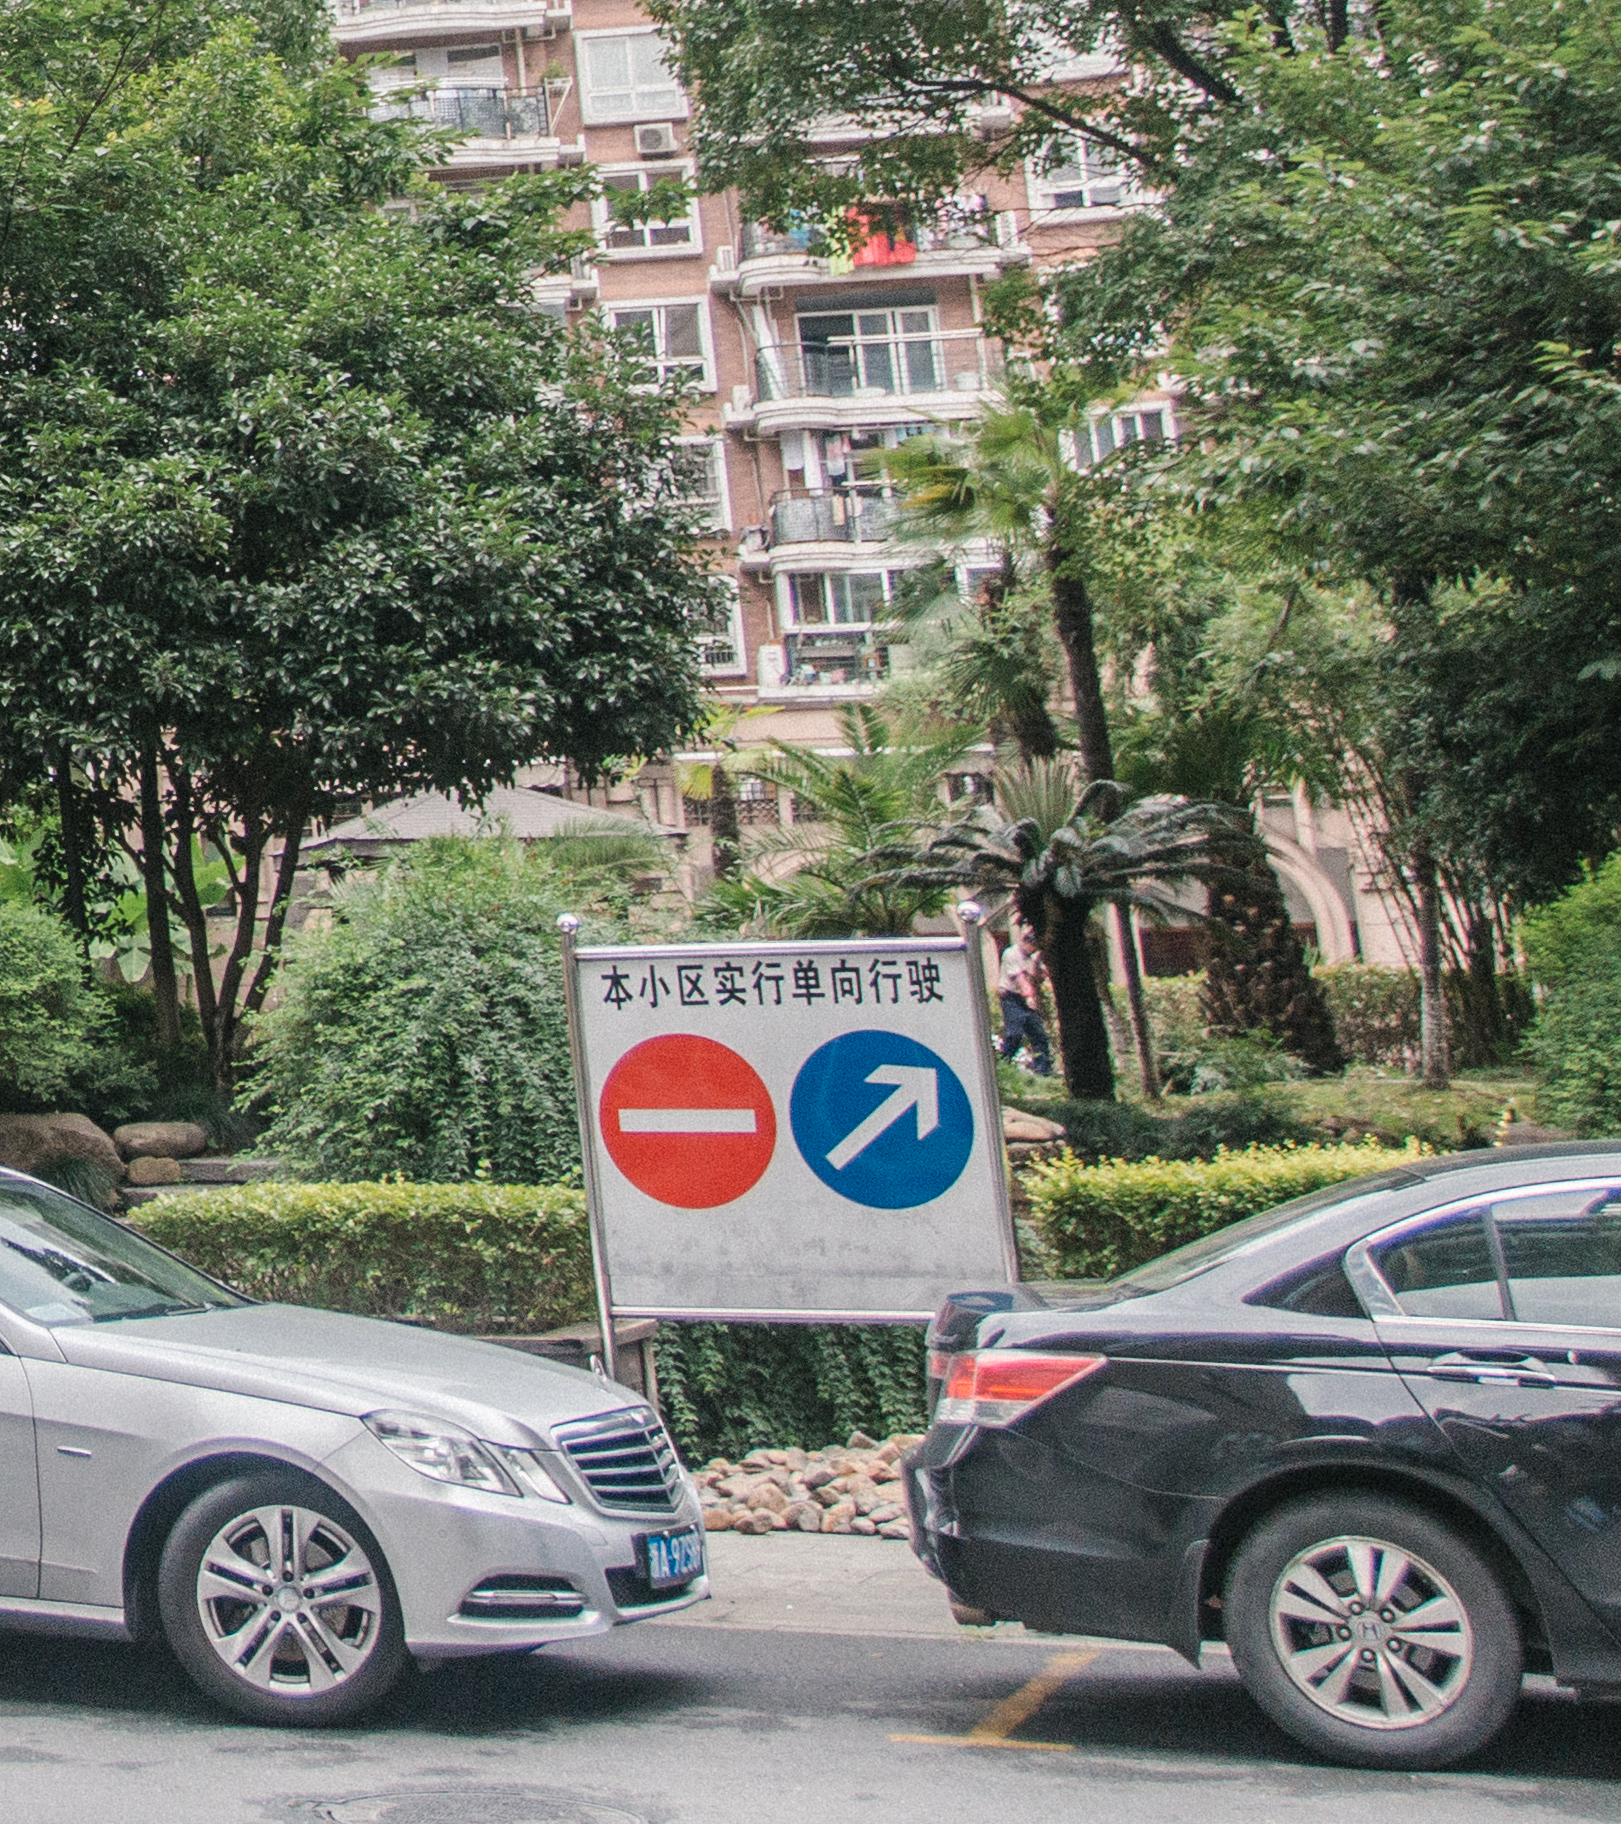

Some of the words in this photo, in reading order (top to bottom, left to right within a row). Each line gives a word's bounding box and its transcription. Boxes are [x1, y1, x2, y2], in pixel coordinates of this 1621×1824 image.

[600, 957, 944, 1010] 本小区实行单向行驶
